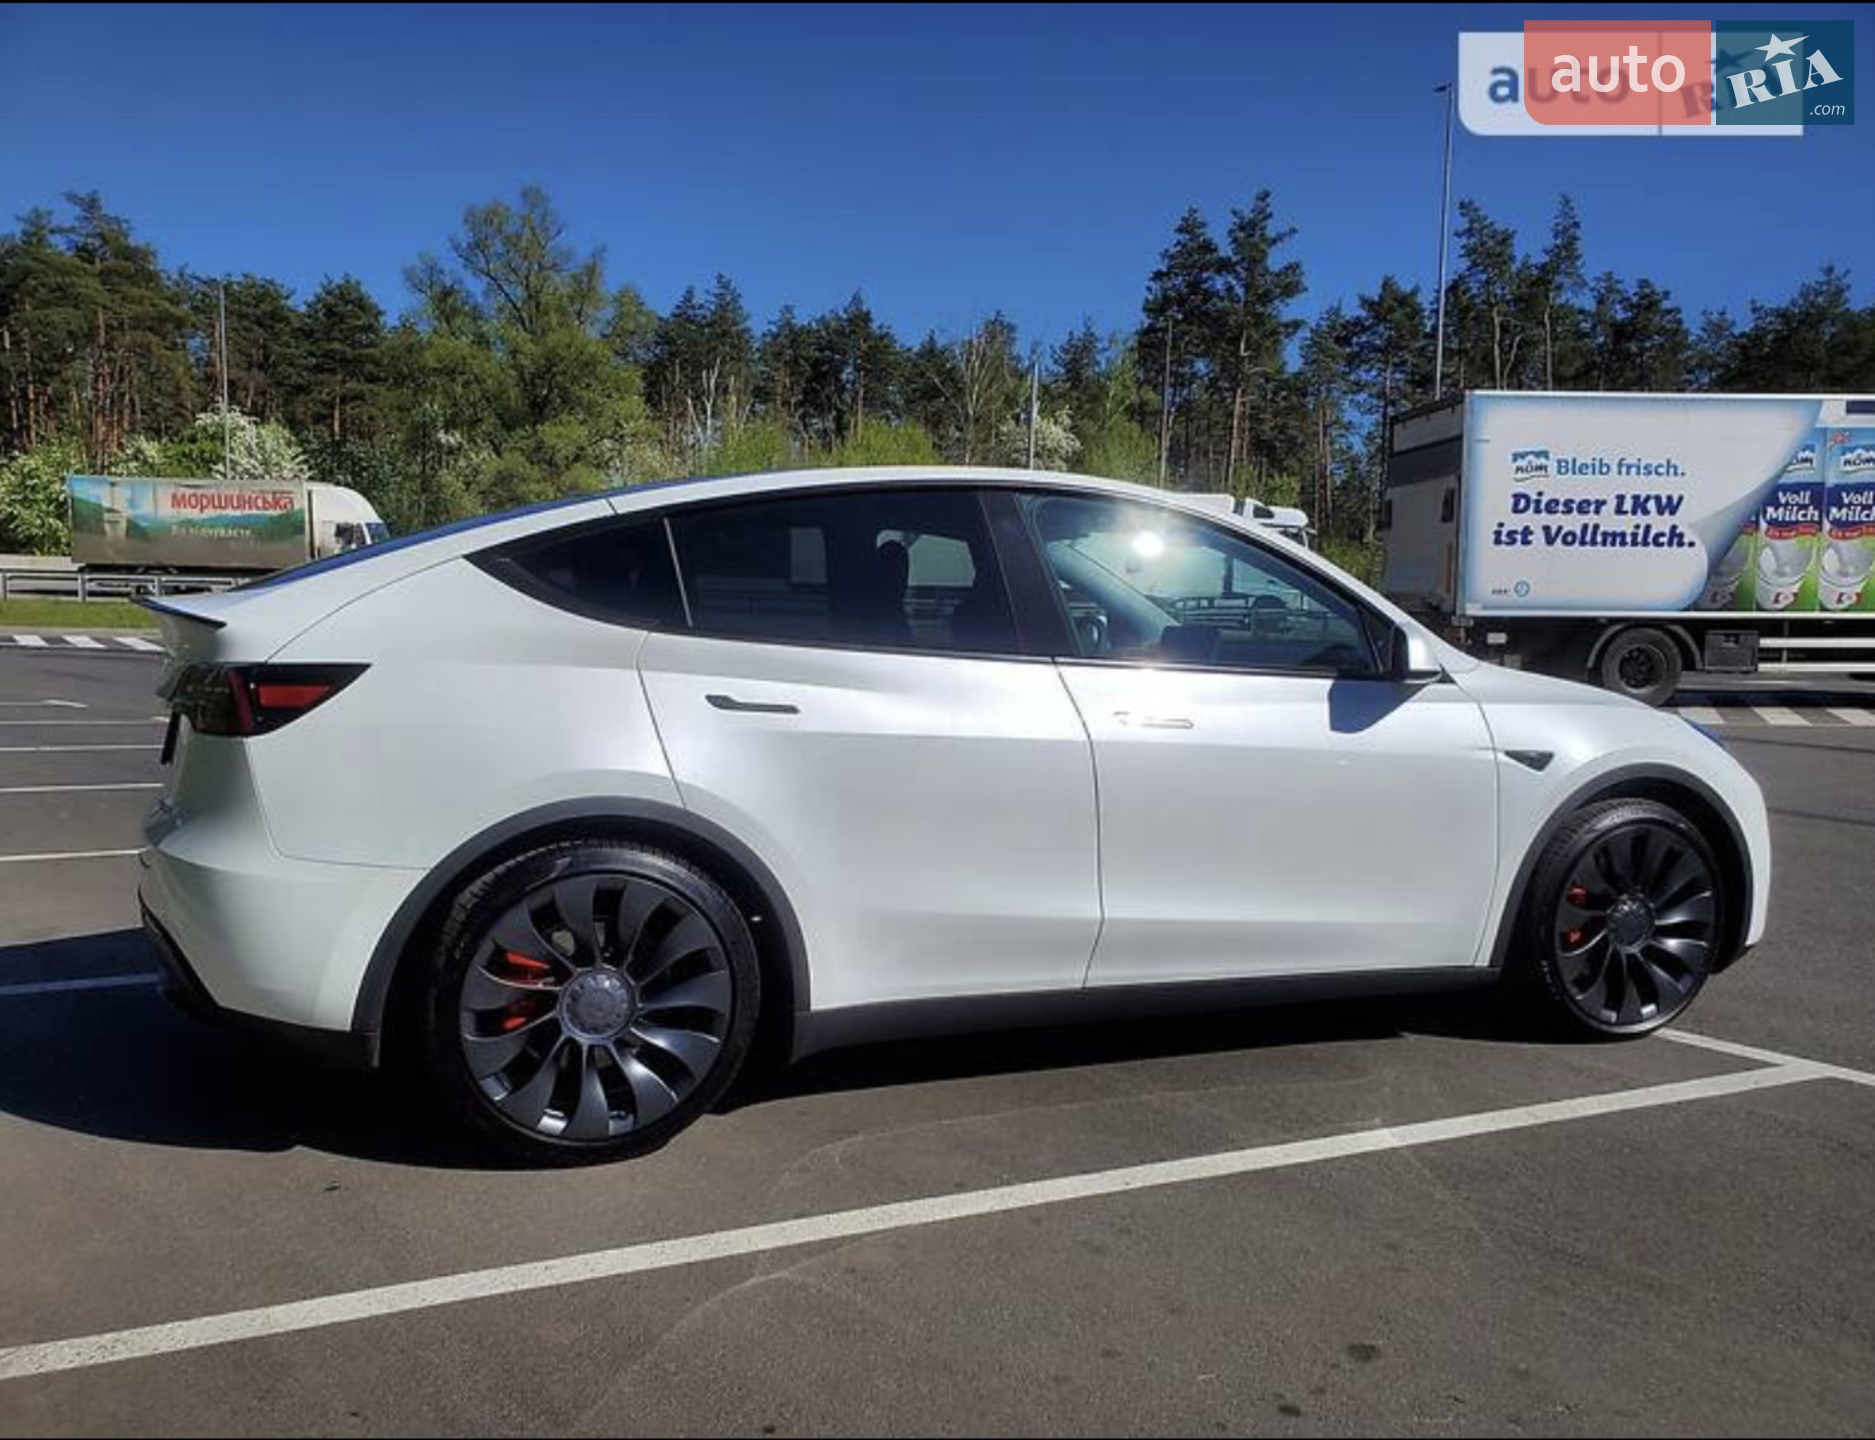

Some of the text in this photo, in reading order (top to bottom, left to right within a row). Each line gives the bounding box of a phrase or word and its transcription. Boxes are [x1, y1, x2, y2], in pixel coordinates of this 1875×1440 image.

[1555, 457, 1687, 477] Bleib frisch.
[1511, 491, 1684, 516] Dieser LKW
[1778, 490, 1811, 505] Voll
[1841, 490, 1874, 505] Voll
[1765, 506, 1819, 522] Milch
[1492, 522, 1696, 548] ist Vollmilch.
